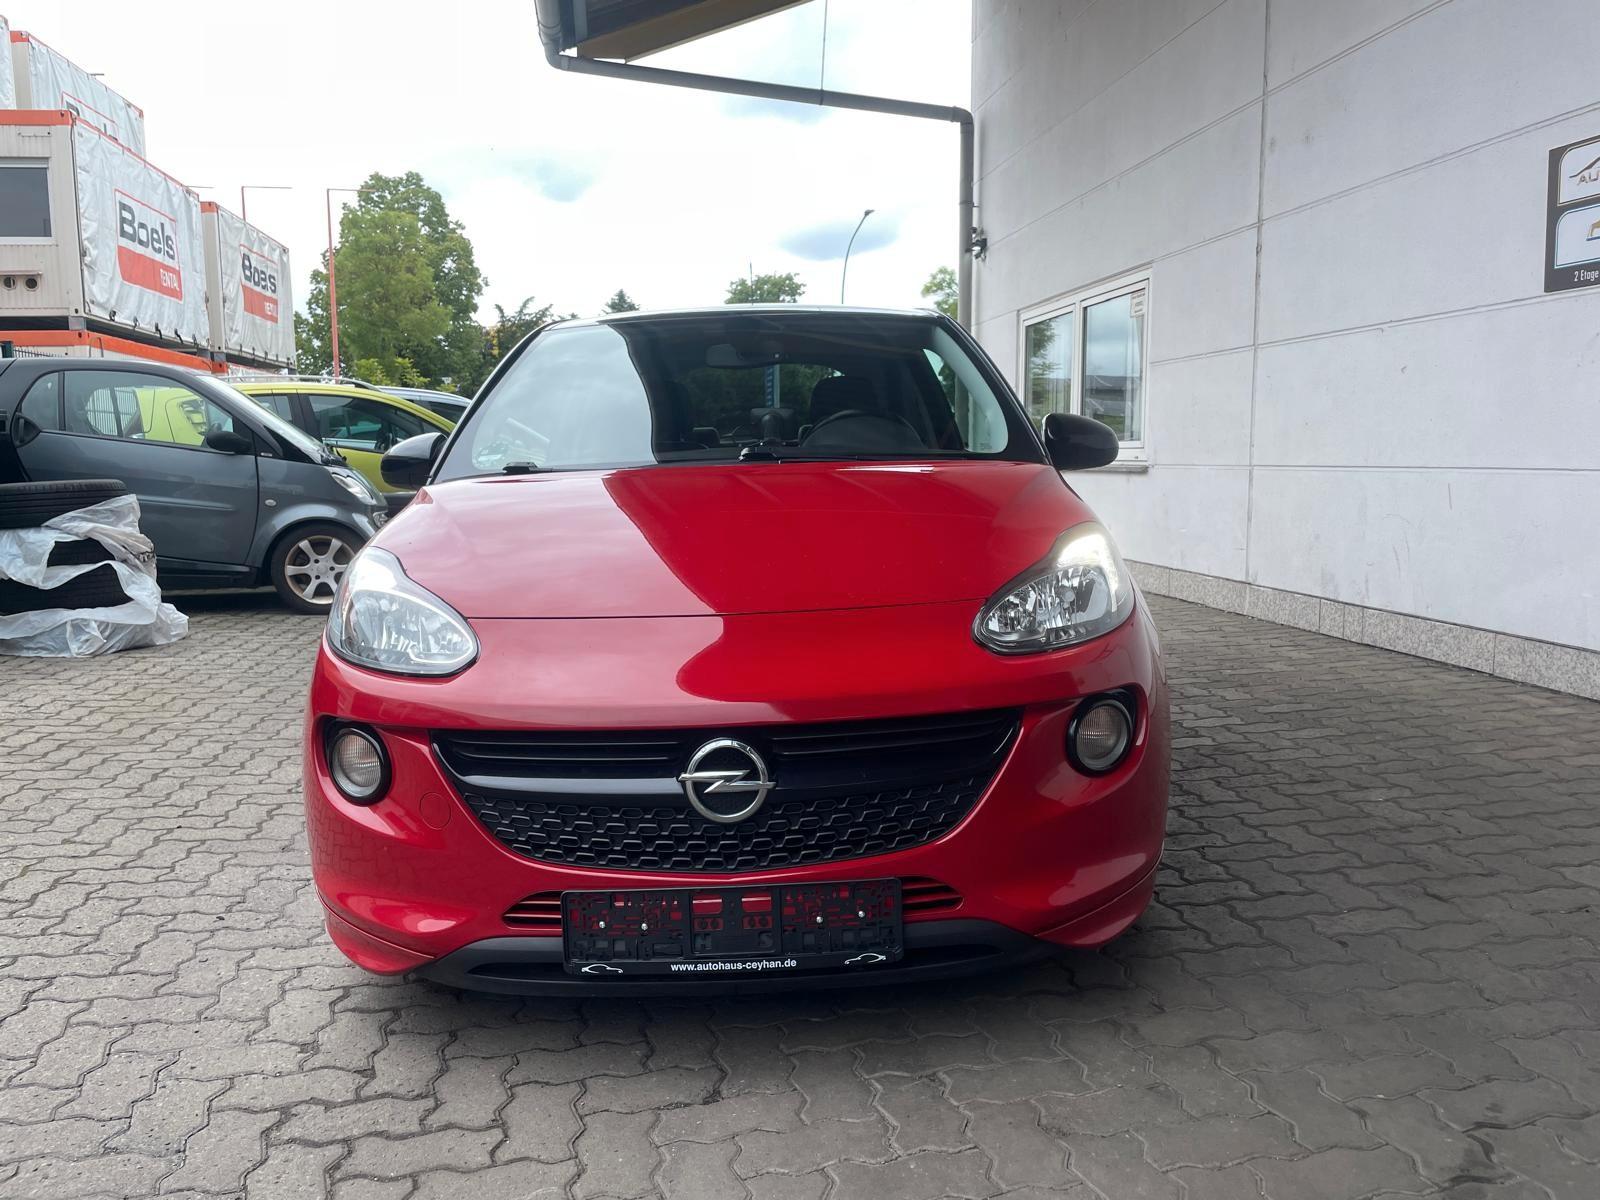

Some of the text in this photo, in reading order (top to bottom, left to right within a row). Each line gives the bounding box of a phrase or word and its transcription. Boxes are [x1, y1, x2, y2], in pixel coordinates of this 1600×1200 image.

[118, 200, 176, 261] Boels
[1574, 270, 1579, 282] 2
[670, 958, 797, 971] www.autohaus-ceyhan.de
